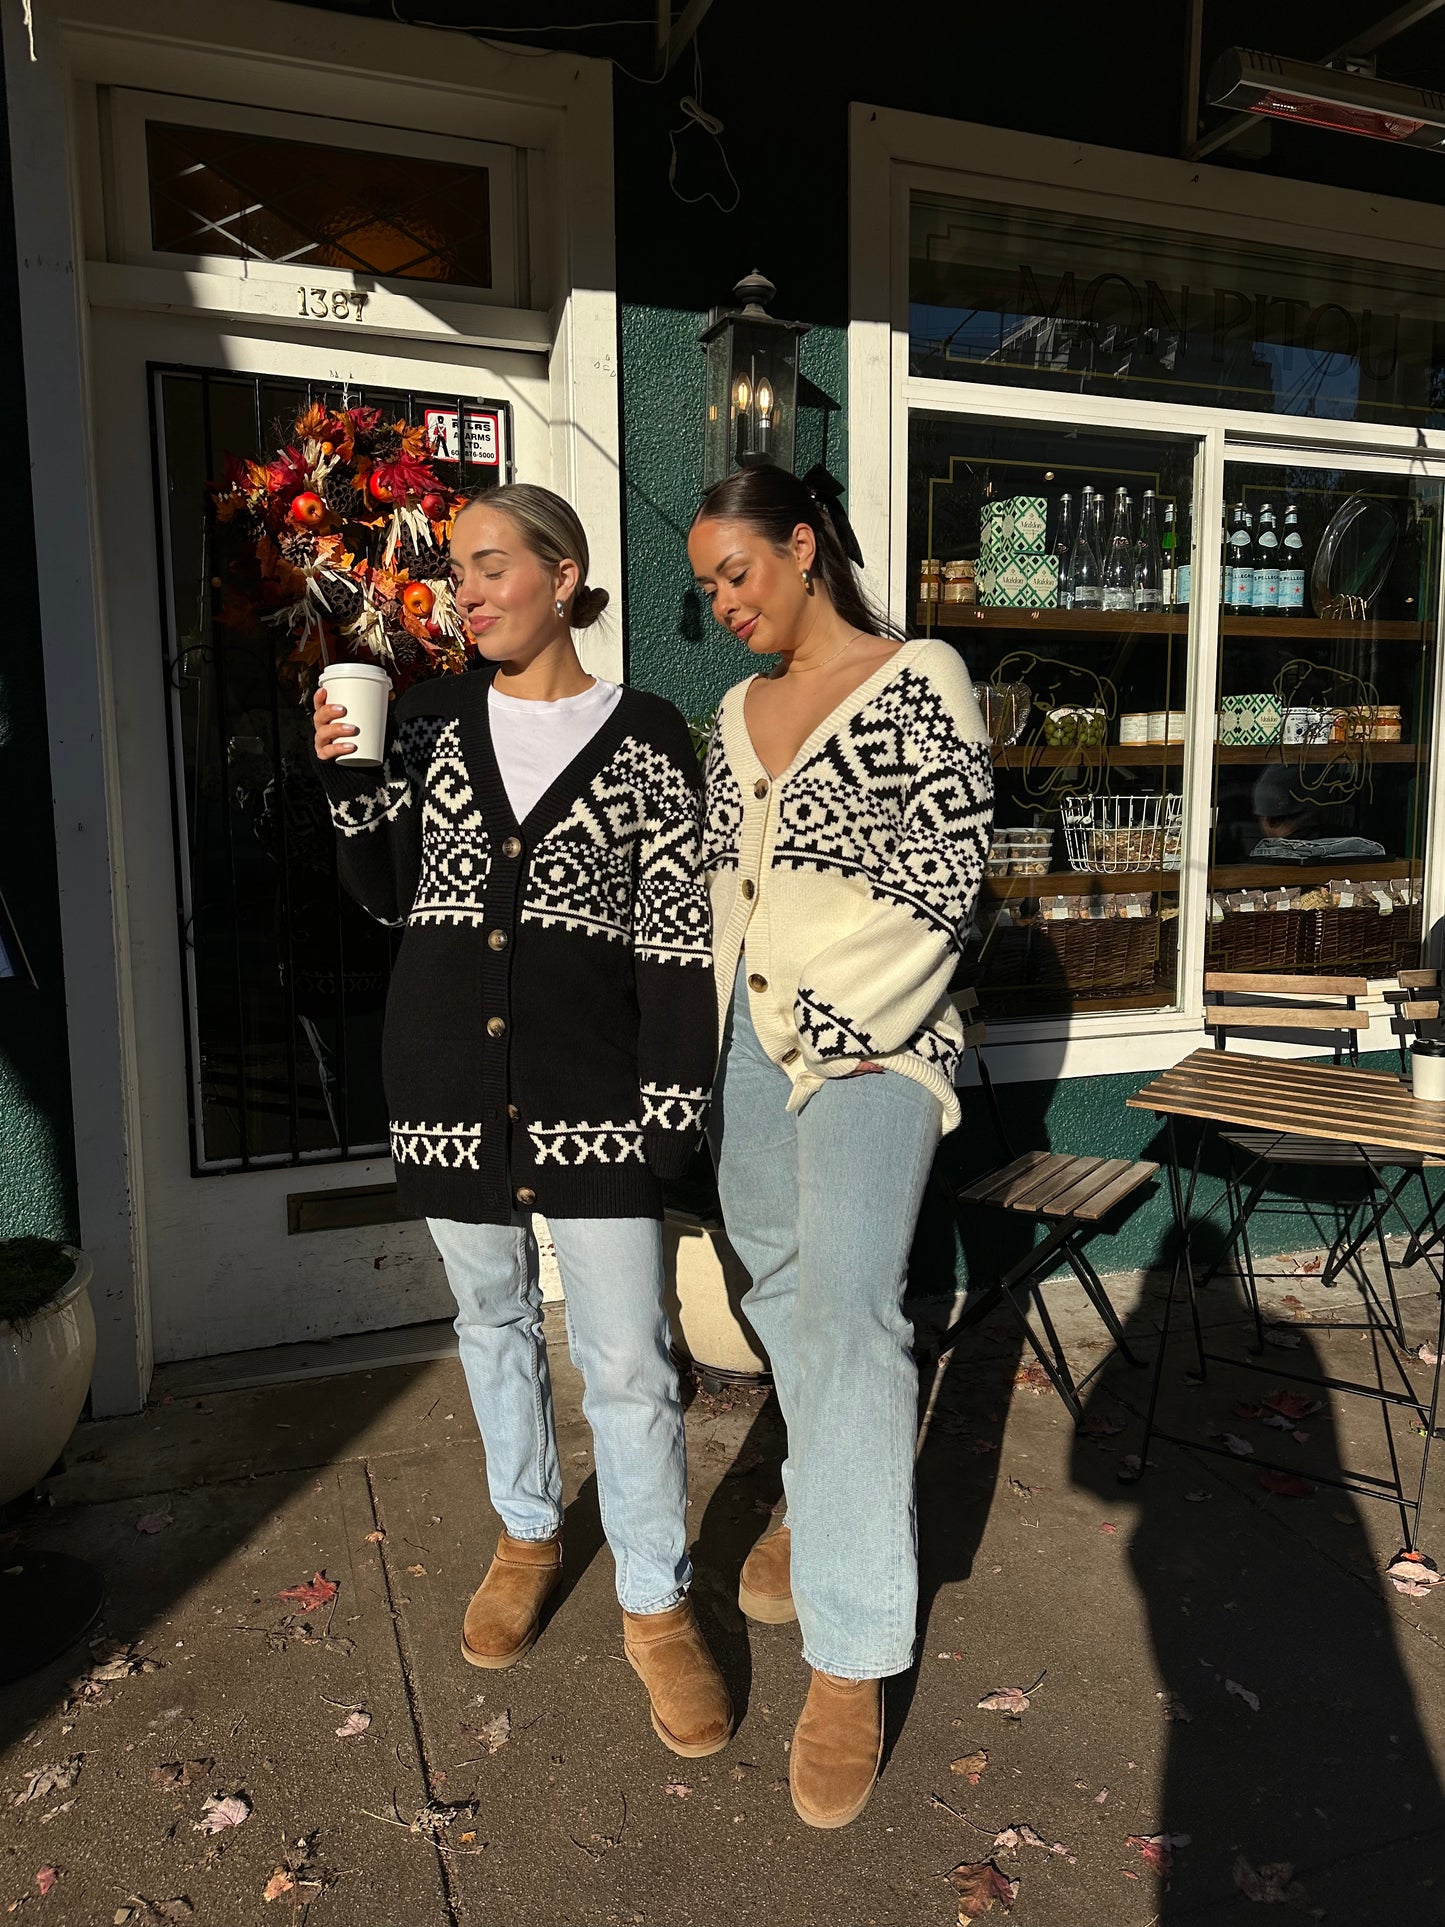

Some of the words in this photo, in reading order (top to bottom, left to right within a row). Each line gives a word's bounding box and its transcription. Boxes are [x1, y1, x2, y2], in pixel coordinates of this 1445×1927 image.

[297, 286, 369, 322] 1387
[1017, 264, 1190, 360] MON
[1212, 287, 1401, 381] PITOU
[453, 432, 491, 442] AARMS
